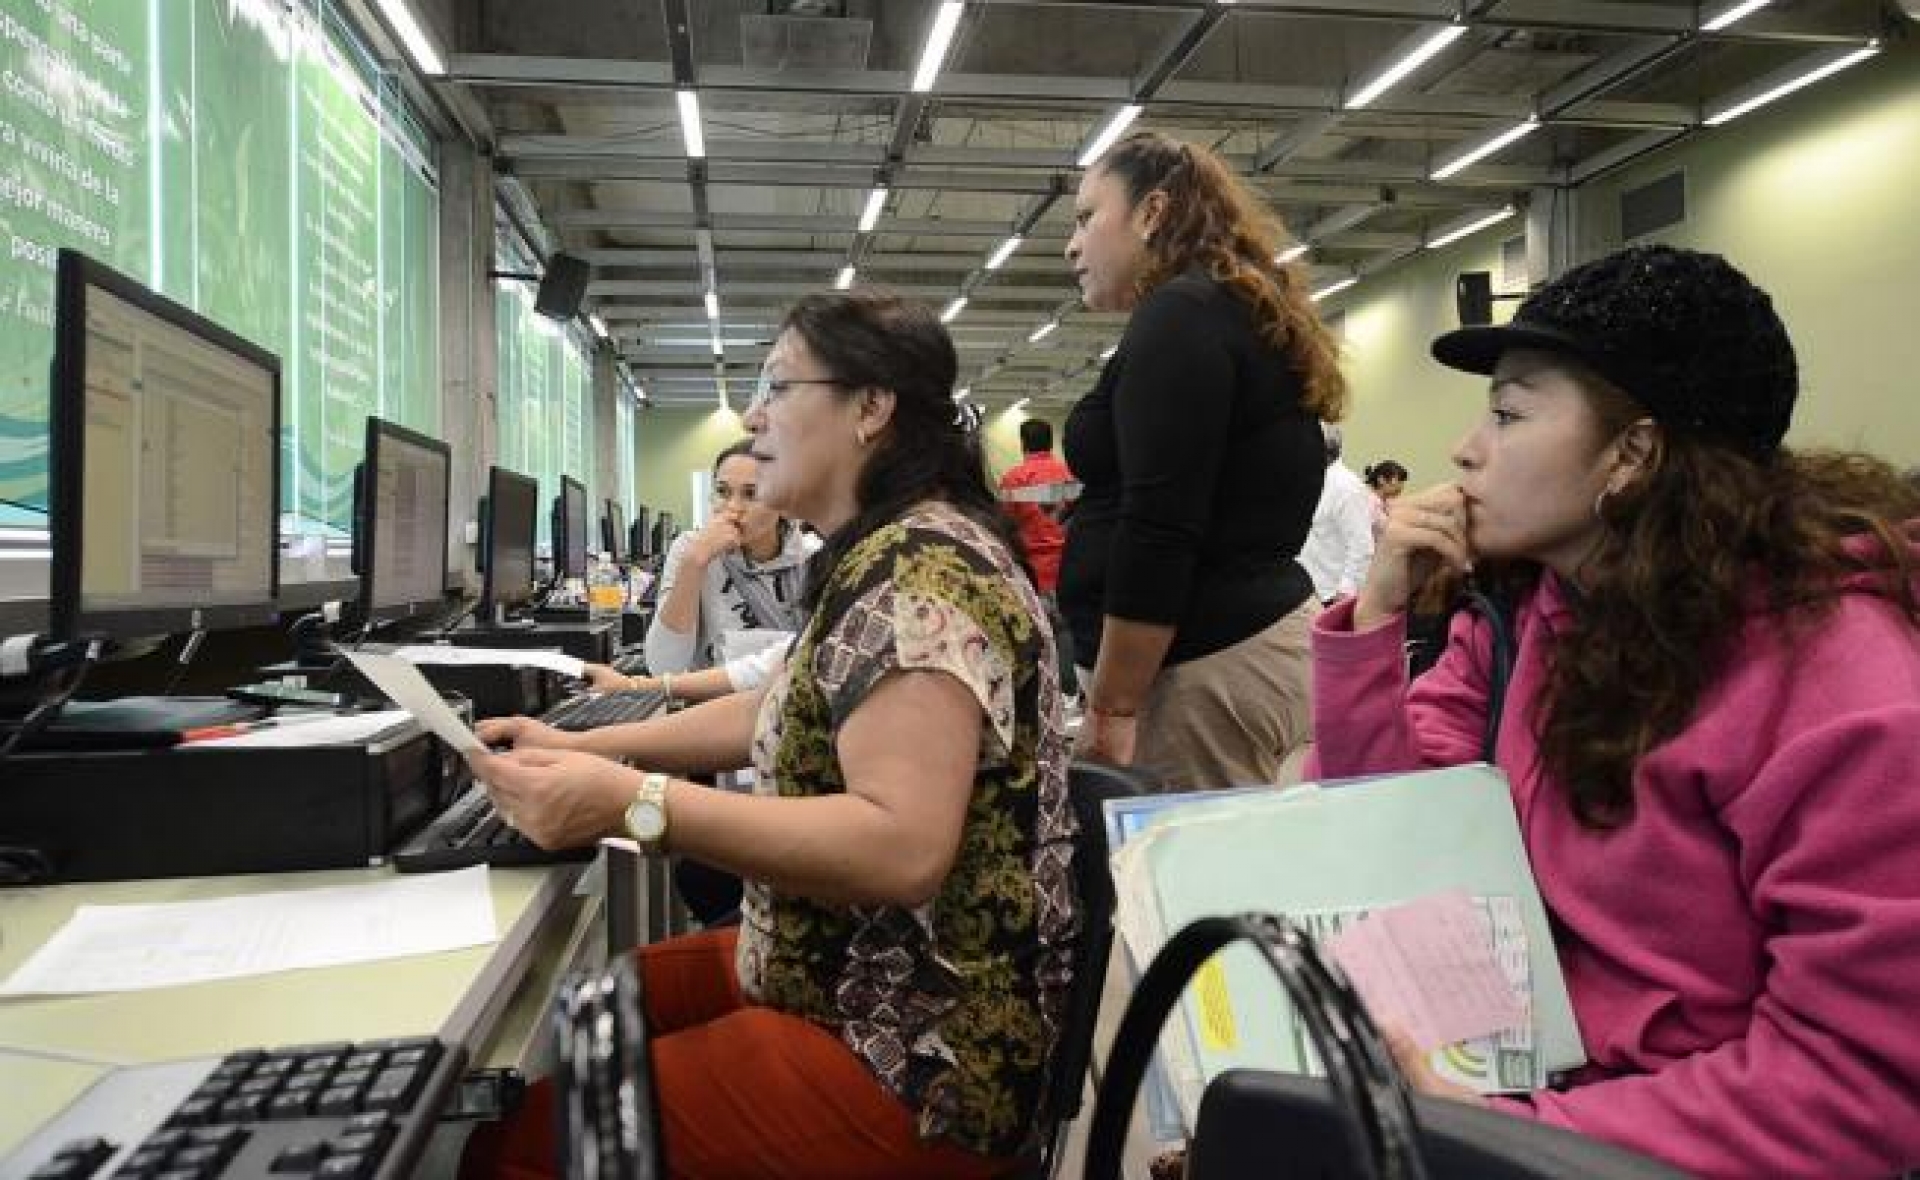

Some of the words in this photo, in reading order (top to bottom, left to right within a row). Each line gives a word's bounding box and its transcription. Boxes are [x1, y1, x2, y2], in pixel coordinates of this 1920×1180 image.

[3, 70, 56, 118] como
[82, 163, 102, 195] de
[105, 176, 119, 204] la
[46, 199, 110, 246] manera
